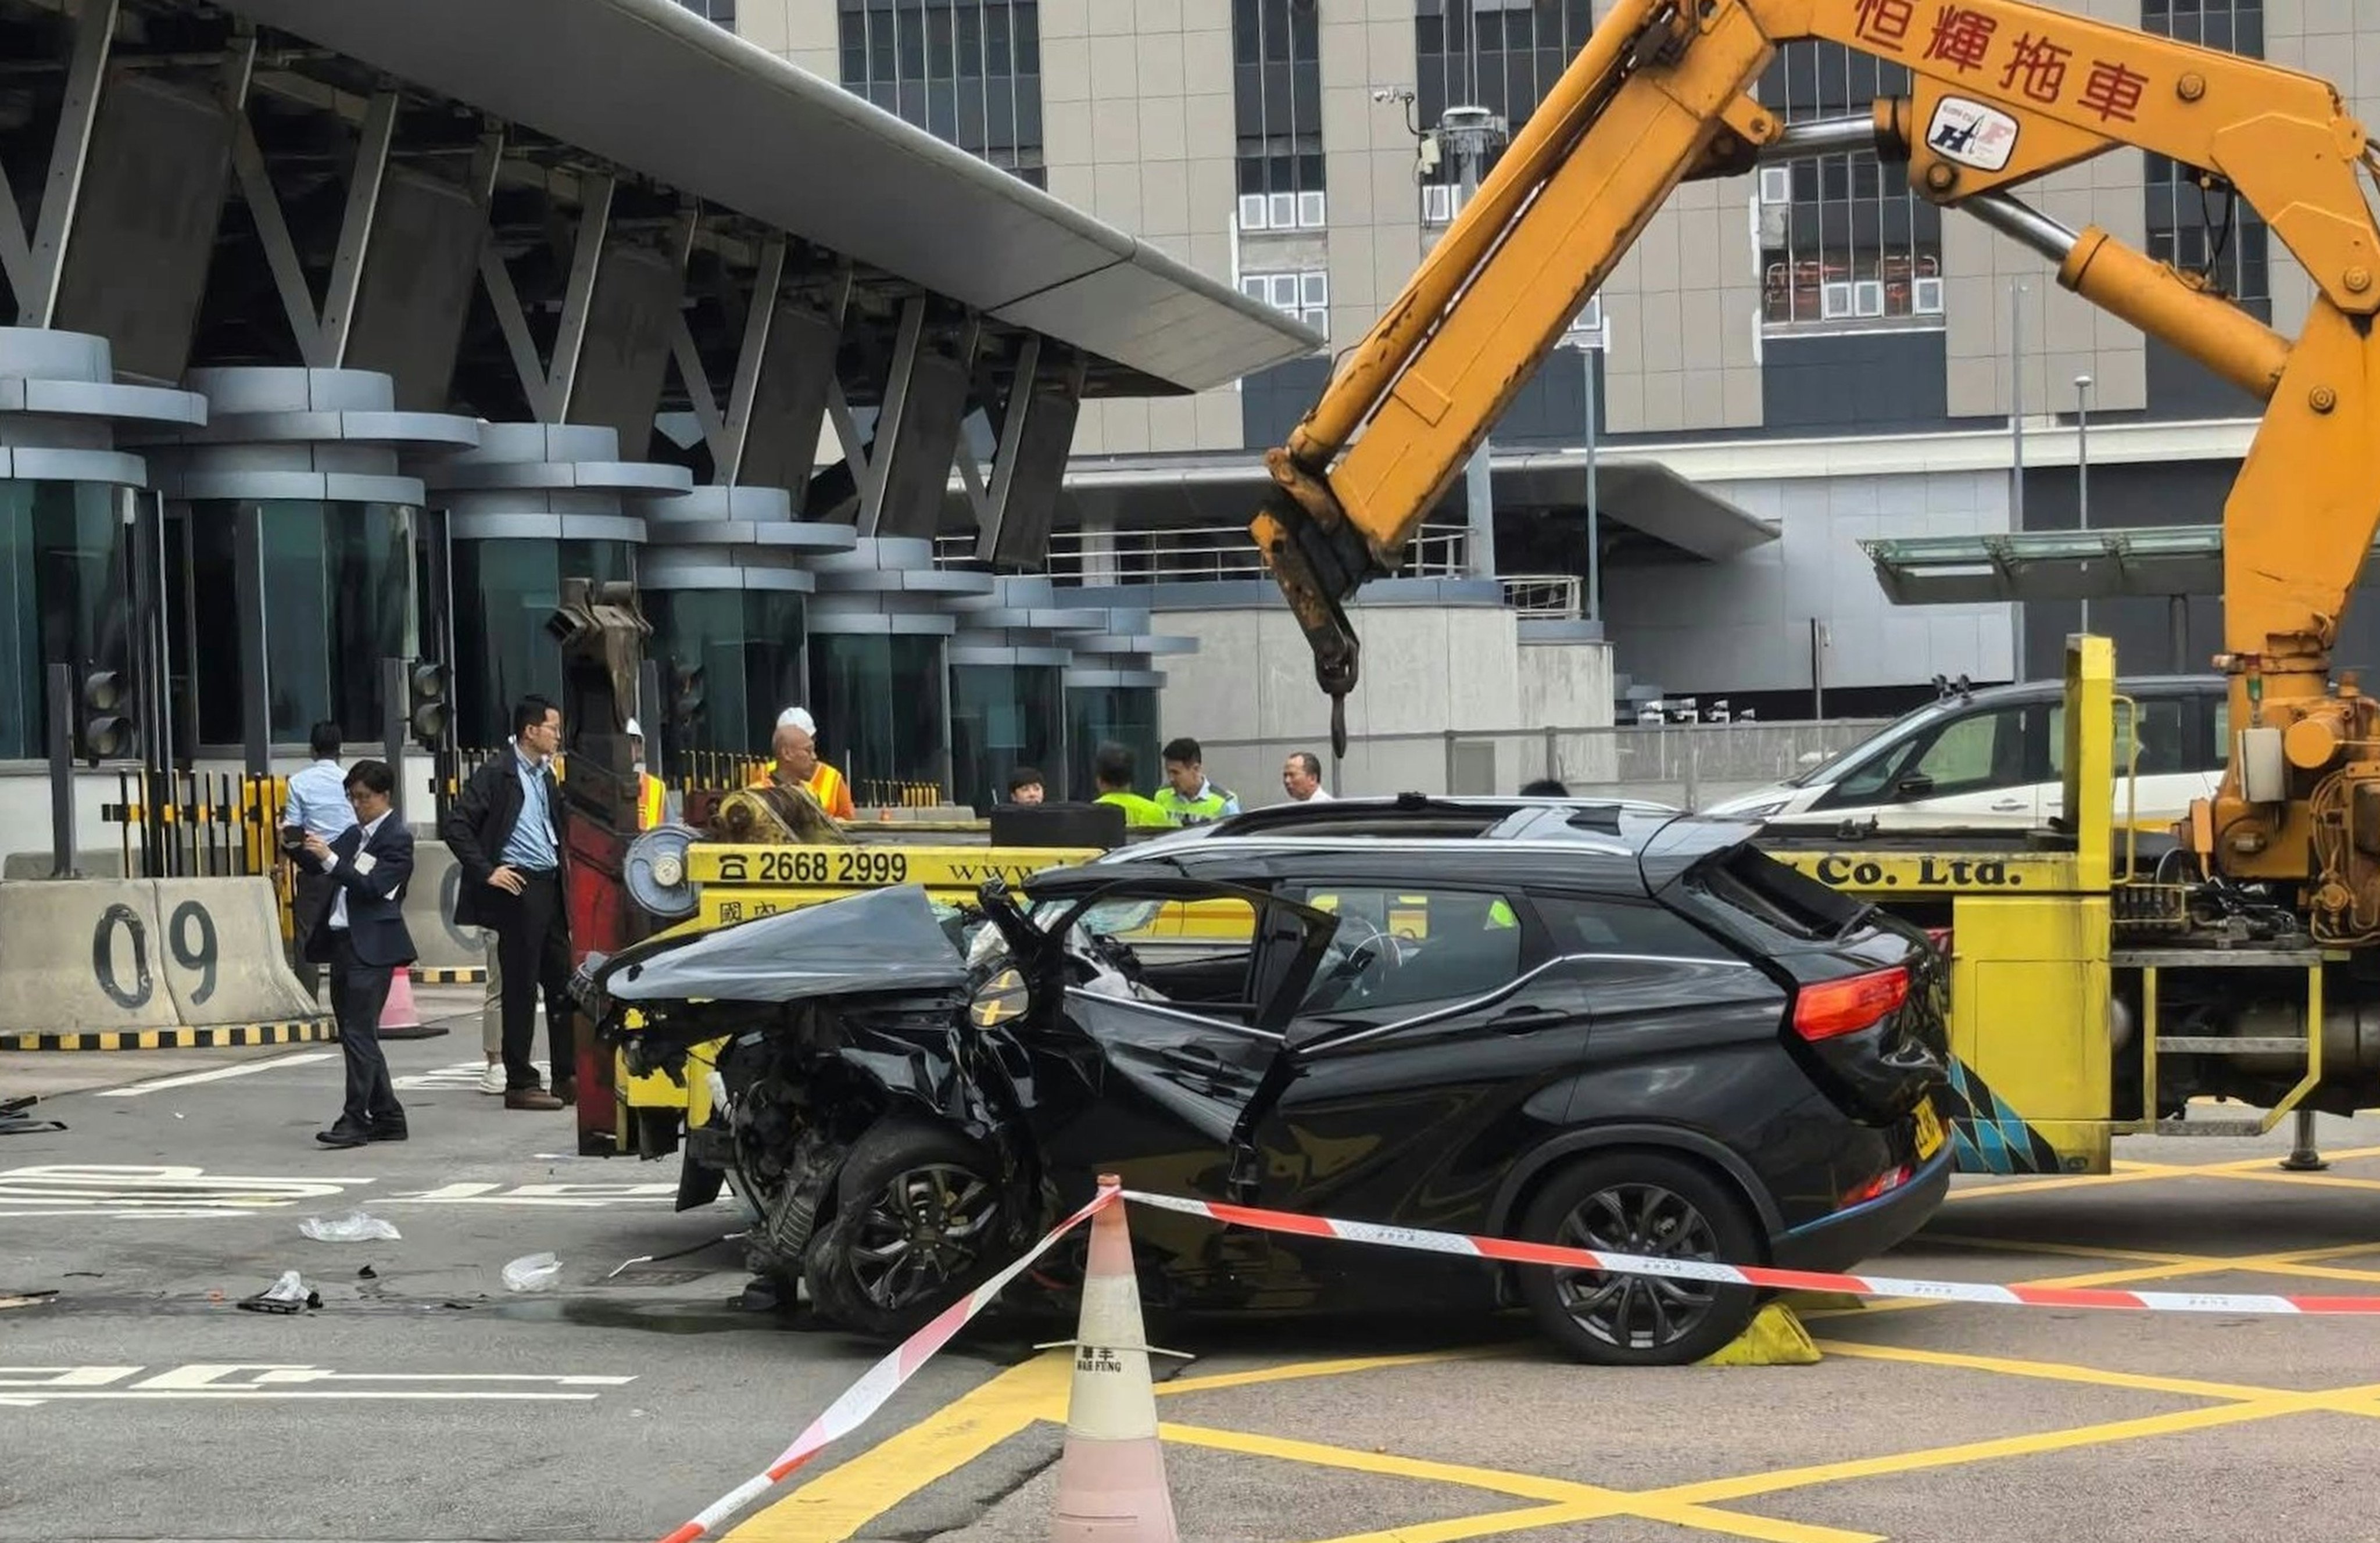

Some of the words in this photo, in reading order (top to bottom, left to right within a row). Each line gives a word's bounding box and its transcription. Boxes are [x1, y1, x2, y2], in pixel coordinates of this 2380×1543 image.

[1855, 0, 2149, 123] 恒輝拖車
[759, 852, 828, 882] 2668
[838, 853, 907, 883] 2999
[1817, 857, 1897, 885] Co.
[1918, 856, 2021, 885] Ltd.
[92, 900, 218, 1009] 09
